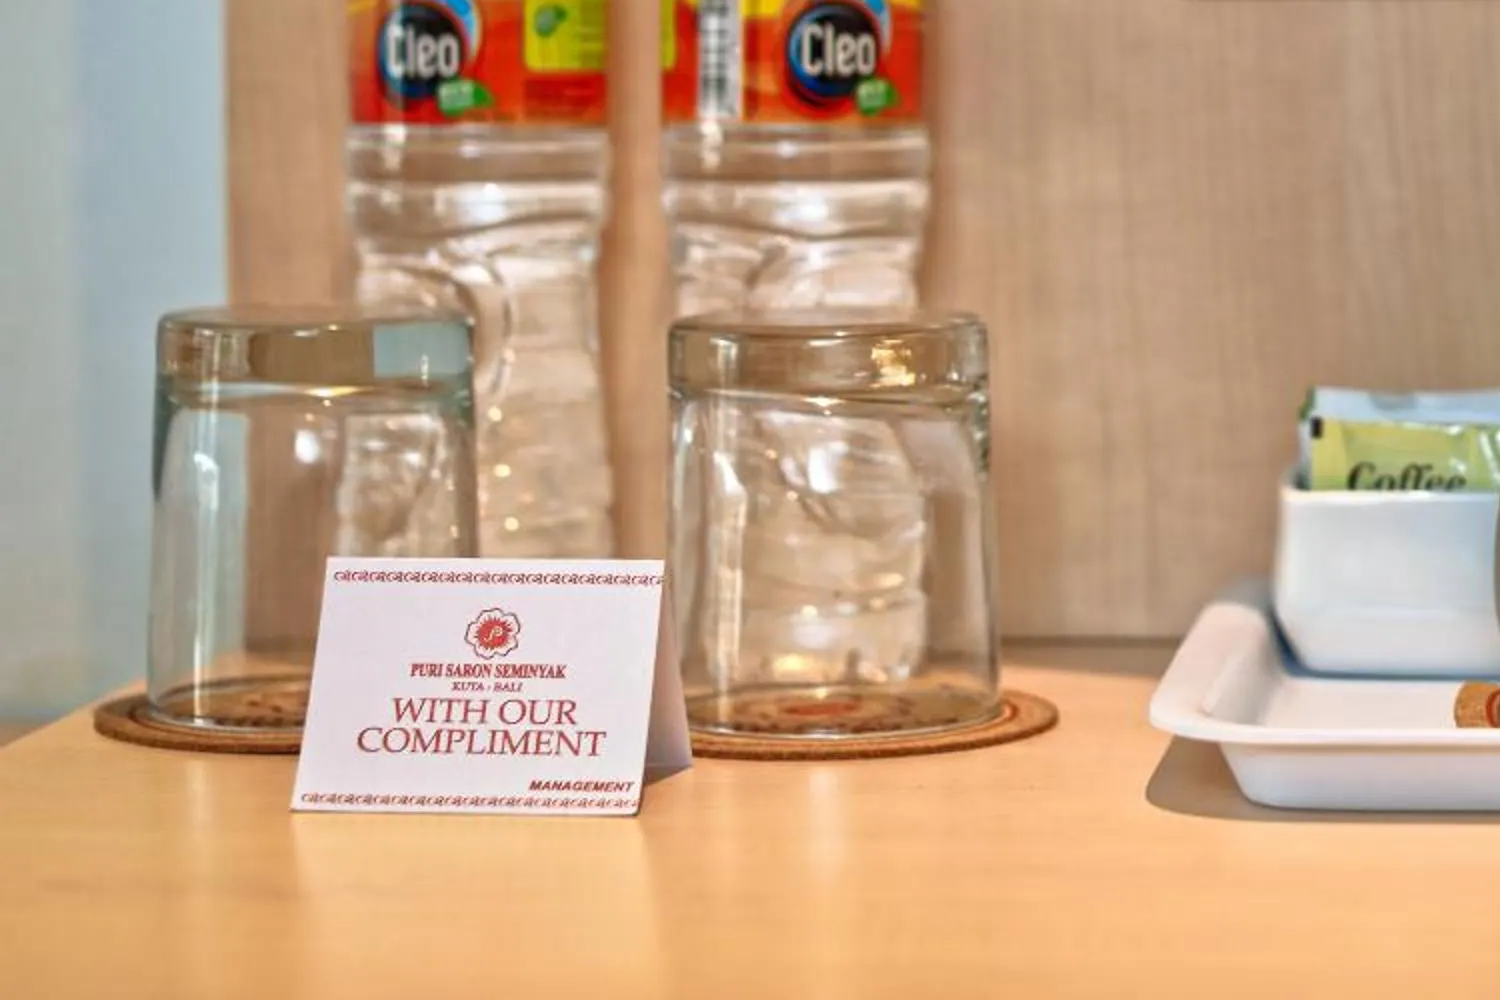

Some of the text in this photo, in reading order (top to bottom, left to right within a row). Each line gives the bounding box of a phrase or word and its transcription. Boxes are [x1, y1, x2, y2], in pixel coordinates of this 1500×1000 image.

[386, 23, 460, 78] Cleo
[801, 22, 876, 76] Cleo
[1347, 461, 1467, 491] Coffee
[410, 663, 567, 679] PURI SARON SEMINYAK
[452, 682, 485, 691] KUTA
[494, 682, 523, 692] BALI
[392, 697, 577, 725] WITH OUR
[357, 727, 607, 757] COMPLIMENT
[529, 780, 635, 793] MANAGEMENT
